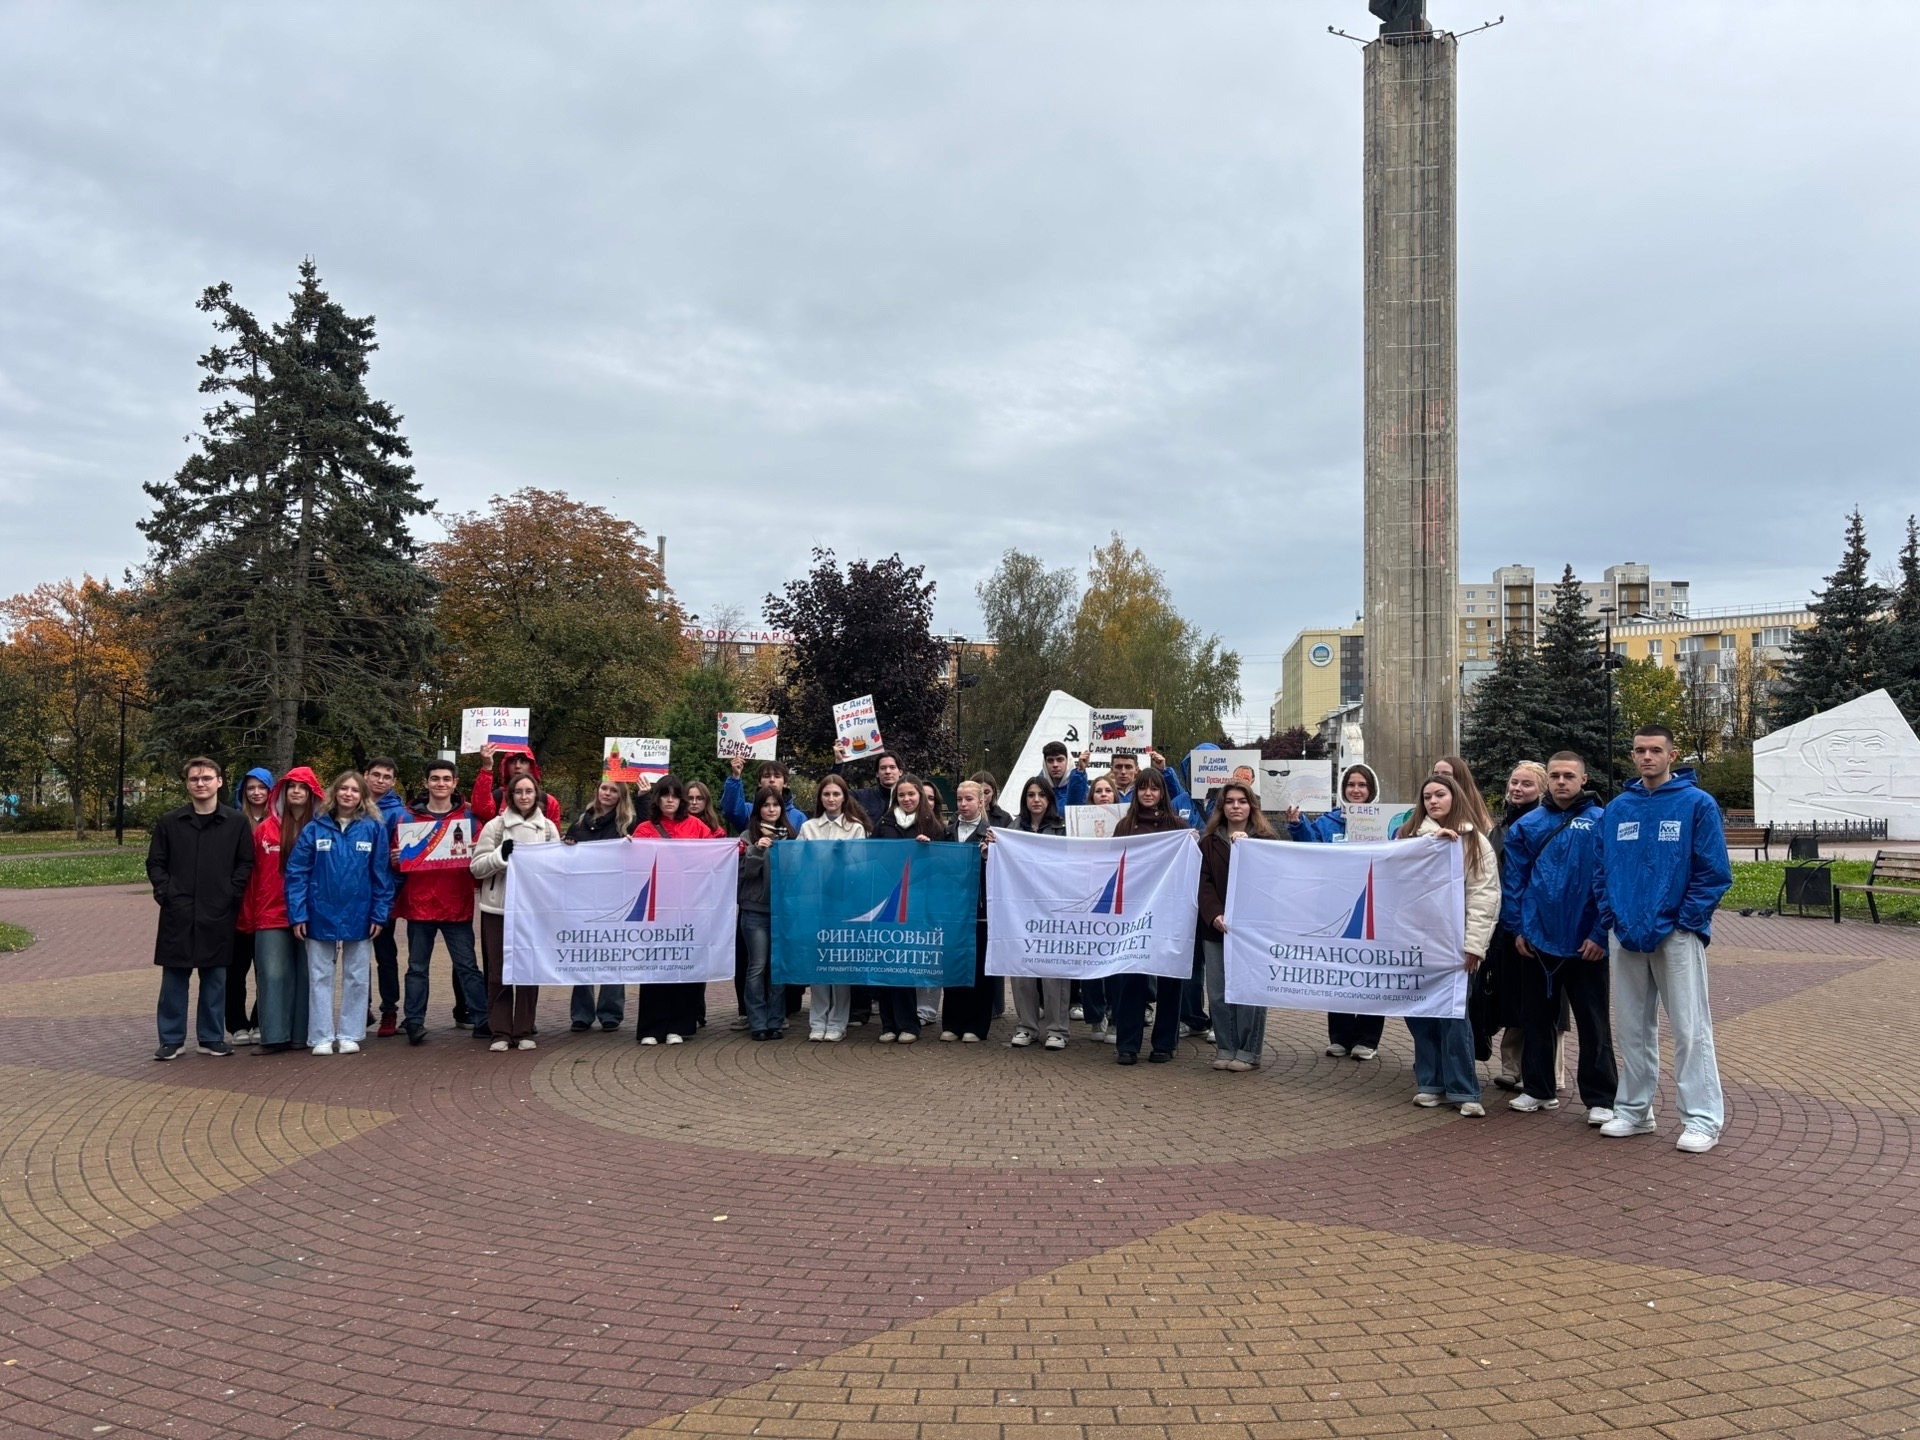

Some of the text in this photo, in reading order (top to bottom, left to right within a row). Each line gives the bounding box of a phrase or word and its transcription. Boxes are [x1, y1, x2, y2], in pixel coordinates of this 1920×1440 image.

[1025, 911, 1154, 936] ФИНАНСОВЫЙ
[556, 924, 695, 944] ФИНАНСОВЫЙ
[816, 927, 945, 946] ФИНАНСОВЫЙ
[556, 947, 695, 963] УНИВЕРСИТЕТ
[1024, 935, 1152, 957] УНИВЕРСИТЕТ
[1269, 944, 1424, 967] ФИНАНСОВЫЙ
[816, 948, 944, 965] УНИВЕРСИТЕТ
[1268, 964, 1424, 991] УНИВЕРСИТЕТ
[1280, 986, 1333, 997] ПРАВИТЕЛЬСТВЕ
[1334, 991, 1381, 1000] РОССИЙСКОЙ
[1382, 994, 1427, 1002] ФЕДЕРАЦИИ
